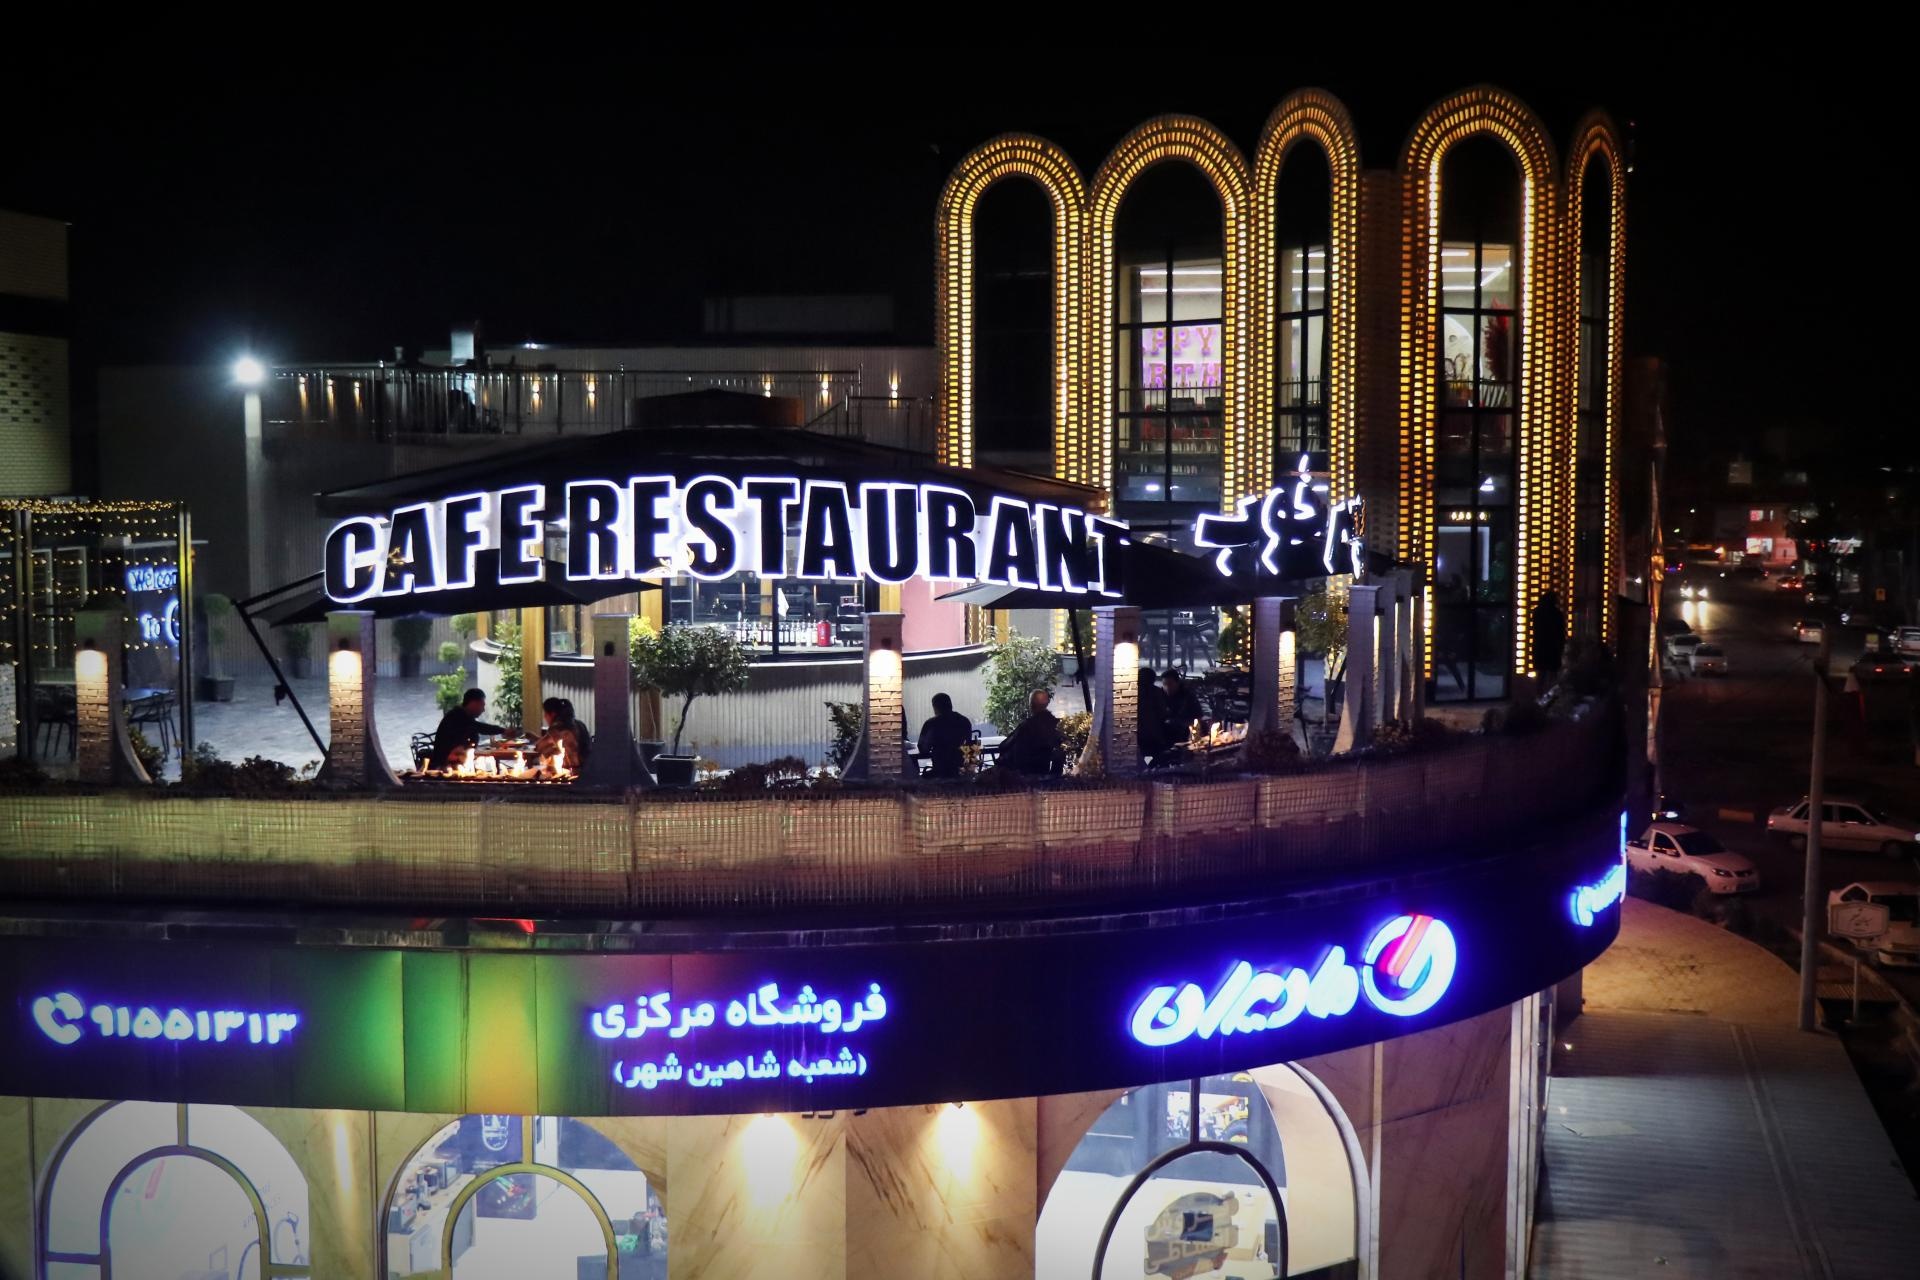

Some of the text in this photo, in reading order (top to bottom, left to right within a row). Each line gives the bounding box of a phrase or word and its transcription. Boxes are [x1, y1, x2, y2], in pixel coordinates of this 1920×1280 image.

[324, 483, 546, 604] CAFE
[564, 475, 1131, 597] RESTAURANT
[91, 1004, 297, 1045] ۹۱۵۵۱۳۱۳
[591, 983, 887, 1038] فروشگاه مرکزی
[687, 1050, 780, 1087] شاهین
[787, 1047, 867, 1083] (شعبه
